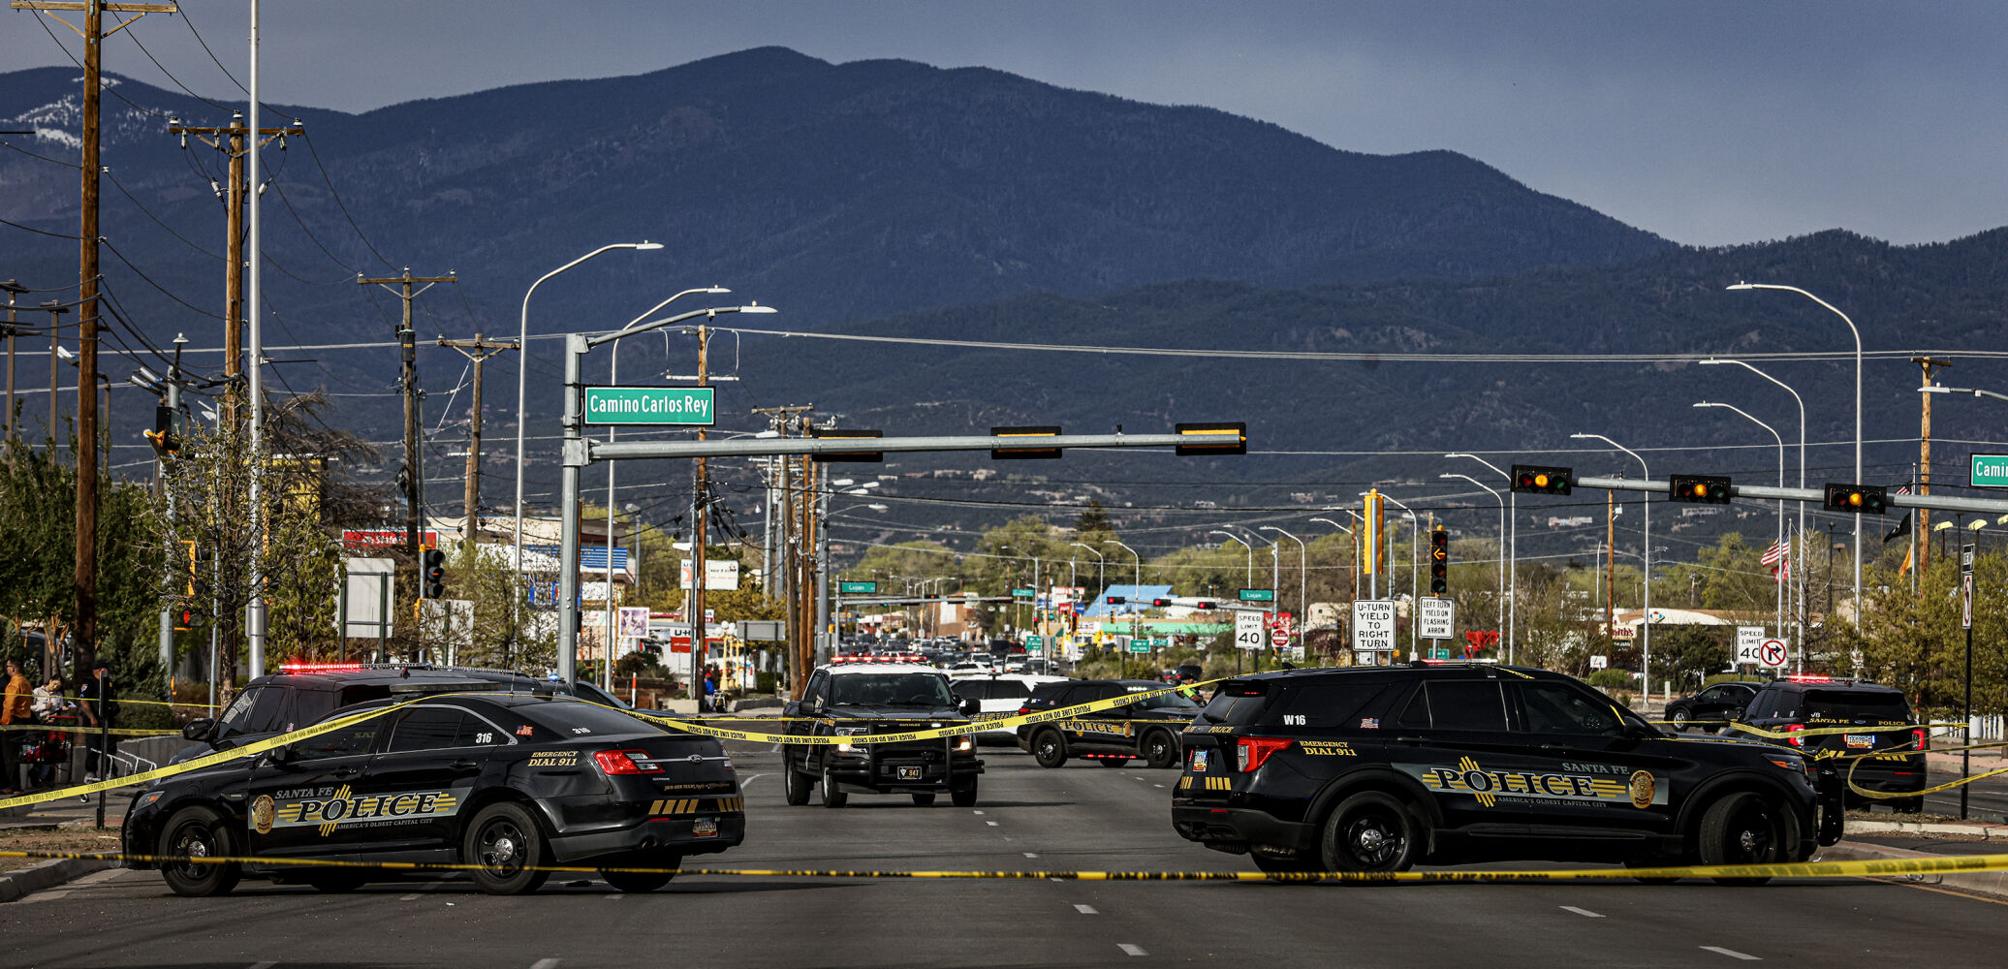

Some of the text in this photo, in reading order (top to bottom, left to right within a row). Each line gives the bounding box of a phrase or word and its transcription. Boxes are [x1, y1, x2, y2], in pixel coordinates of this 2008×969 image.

[590, 395, 709, 418] Camino Carlos Rey
[1358, 603, 1391, 612] U-TURN
[1359, 613, 1390, 621] YIELD
[1368, 622, 1381, 630] TO
[1238, 632, 1260, 644] 40
[1358, 631, 1390, 639] RIGHT
[1360, 640, 1389, 648] TURN
[1062, 709, 1073, 718] LINE
[1074, 705, 1091, 714] POLICE
[1025, 716, 1043, 724] CROSS
[1042, 714, 1053, 722] NOT
[1283, 714, 1306, 726] W16
[974, 725, 986, 733] LINE
[985, 722, 1004, 731] POLICE
[1065, 721, 1115, 734] POLICE
[720, 730, 730, 738] LINE
[730, 732, 747, 740] POLICE
[899, 733, 917, 741] POLICE
[938, 729, 955, 737] CROSS
[476, 733, 492, 744] 316
[767, 735, 783, 743] CROSS
[1300, 740, 1348, 748] EMERGENCY
[531, 750, 578, 758] EMERGENCY
[1304, 747, 1358, 757] DIAL 911
[527, 757, 577, 767] DIAL 911
[1563, 761, 1630, 776] SANTA FE
[1430, 767, 1599, 799] POLICE
[274, 786, 334, 800] SANTA FE
[294, 791, 442, 823] POLICE
[1498, 797, 1535, 805] AMERICA'S
[1536, 798, 1561, 806] OLDEST
[1563, 800, 1591, 808] CAPITAL
[336, 822, 369, 830] AMERICA'S
[393, 818, 419, 826] CAPITAL
